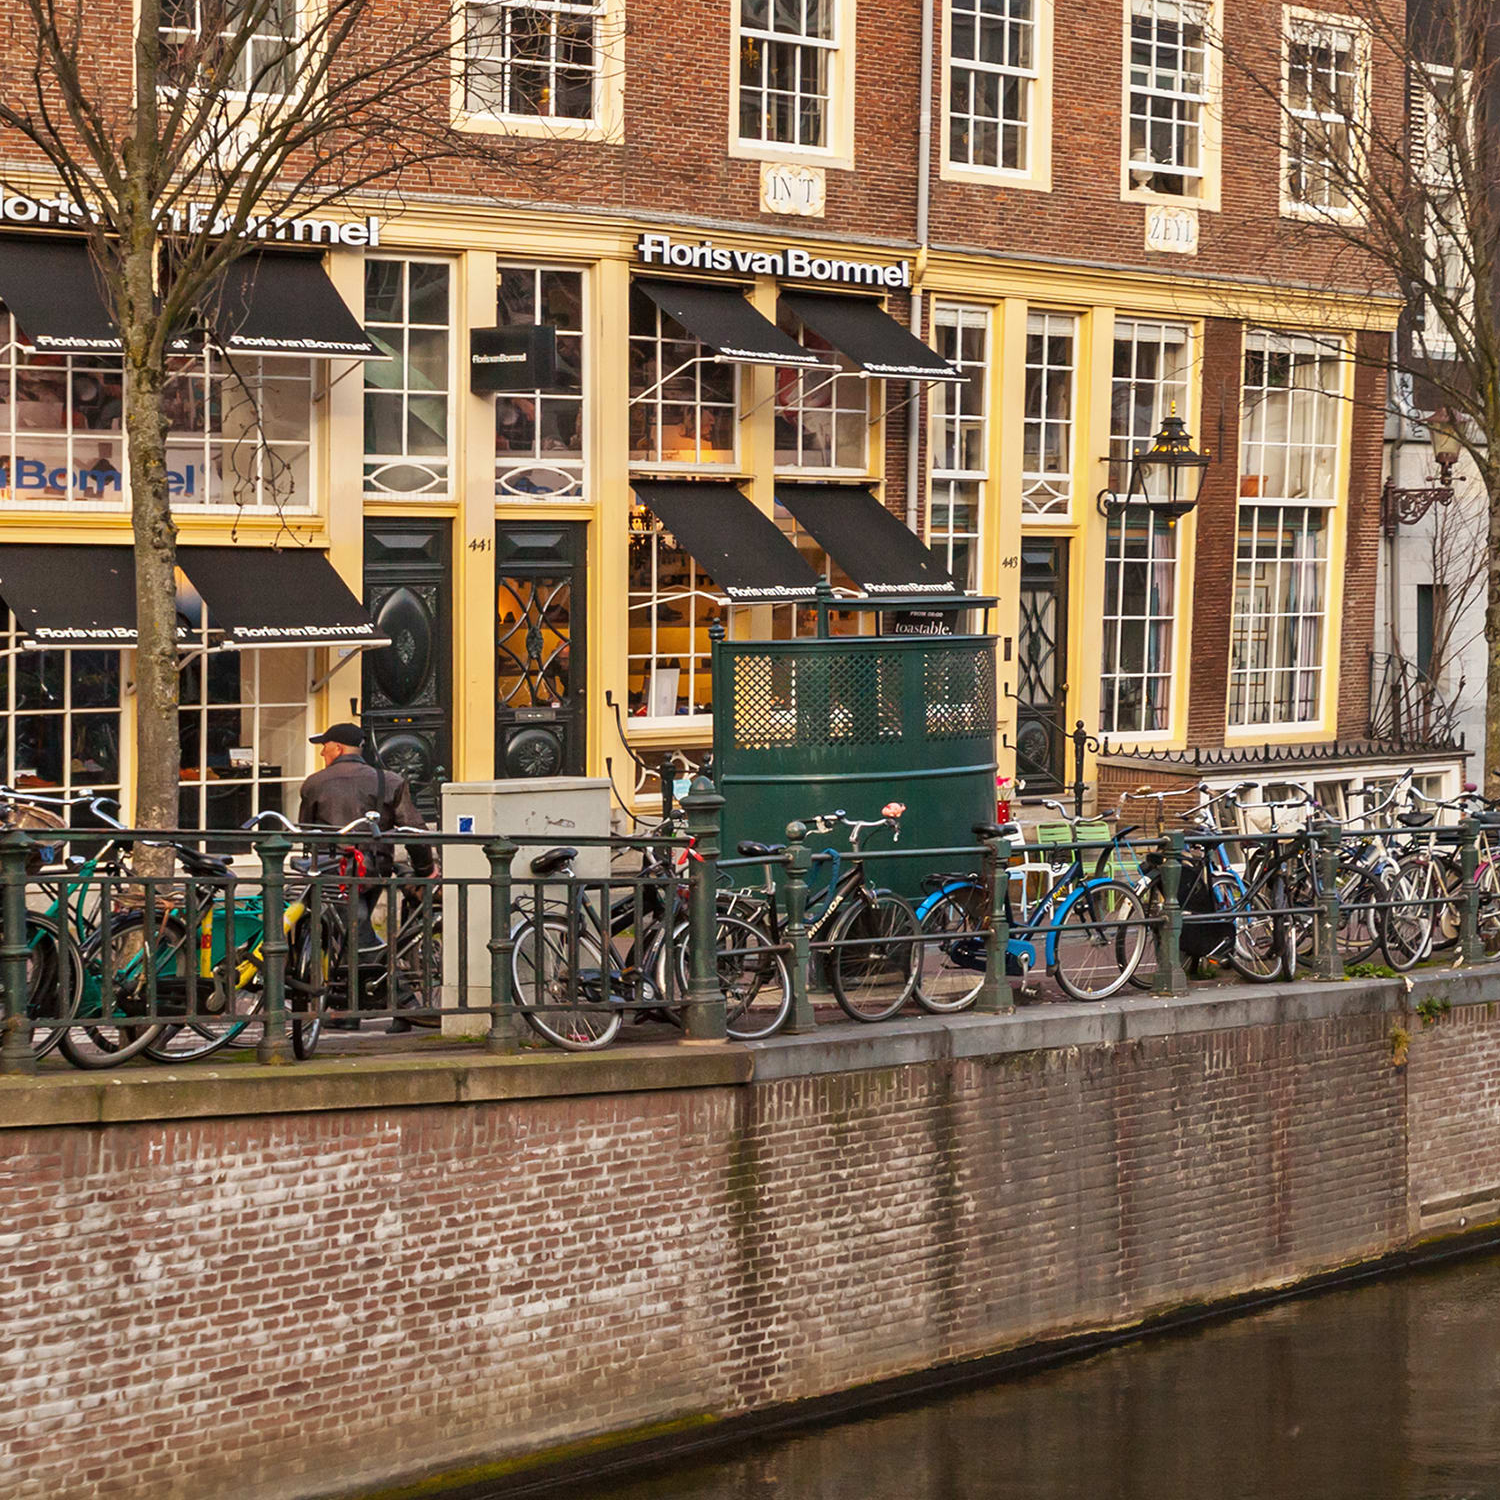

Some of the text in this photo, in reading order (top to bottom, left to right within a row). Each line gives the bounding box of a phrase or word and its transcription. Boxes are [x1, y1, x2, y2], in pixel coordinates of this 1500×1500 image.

[773, 176, 792, 200] IN
[1150, 215, 1192, 242] ZEYL
[639, 233, 908, 288] Floris van Bommel
[230, 335, 371, 351] Floris van Bommel
[468, 538, 491, 551] 441
[1002, 556, 1018, 569] 443
[35, 627, 85, 638] Floris
[85, 629, 114, 638] van
[233, 623, 373, 638] Floris van Bommel
[895, 620, 953, 636] toastable.
